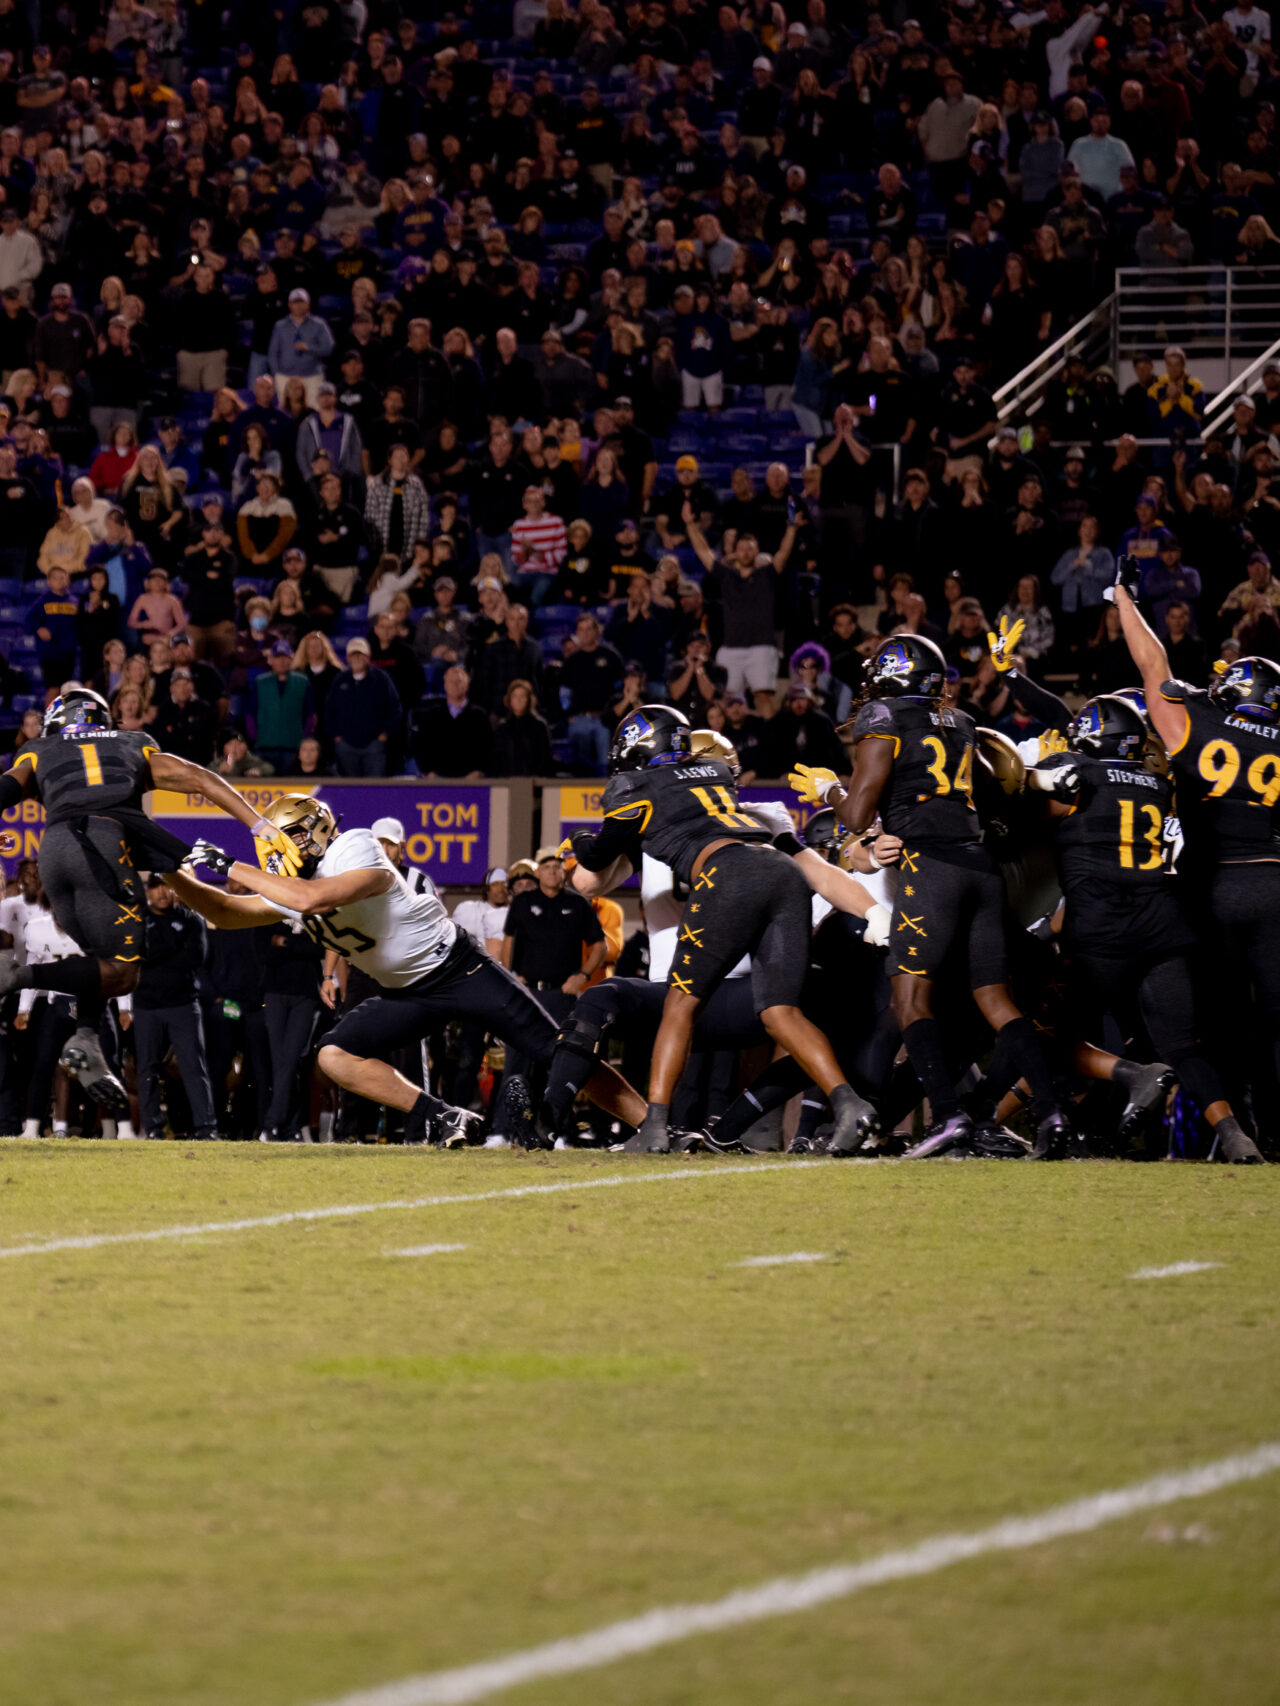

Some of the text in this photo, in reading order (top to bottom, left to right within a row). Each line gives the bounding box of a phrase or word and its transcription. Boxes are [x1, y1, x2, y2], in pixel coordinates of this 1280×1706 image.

[63, 730, 118, 741] FLEMING
[1223, 715, 1280, 741] LAMPLEY
[77, 743, 104, 786] 1
[673, 765, 718, 780] J.LEWIS
[918, 735, 976, 808] 34
[1106, 768, 1159, 790] STEPHENS
[1198, 738, 1280, 808] 99
[416, 803, 478, 828] TOM
[689, 785, 761, 829] 11
[1117, 800, 1163, 870] 13
